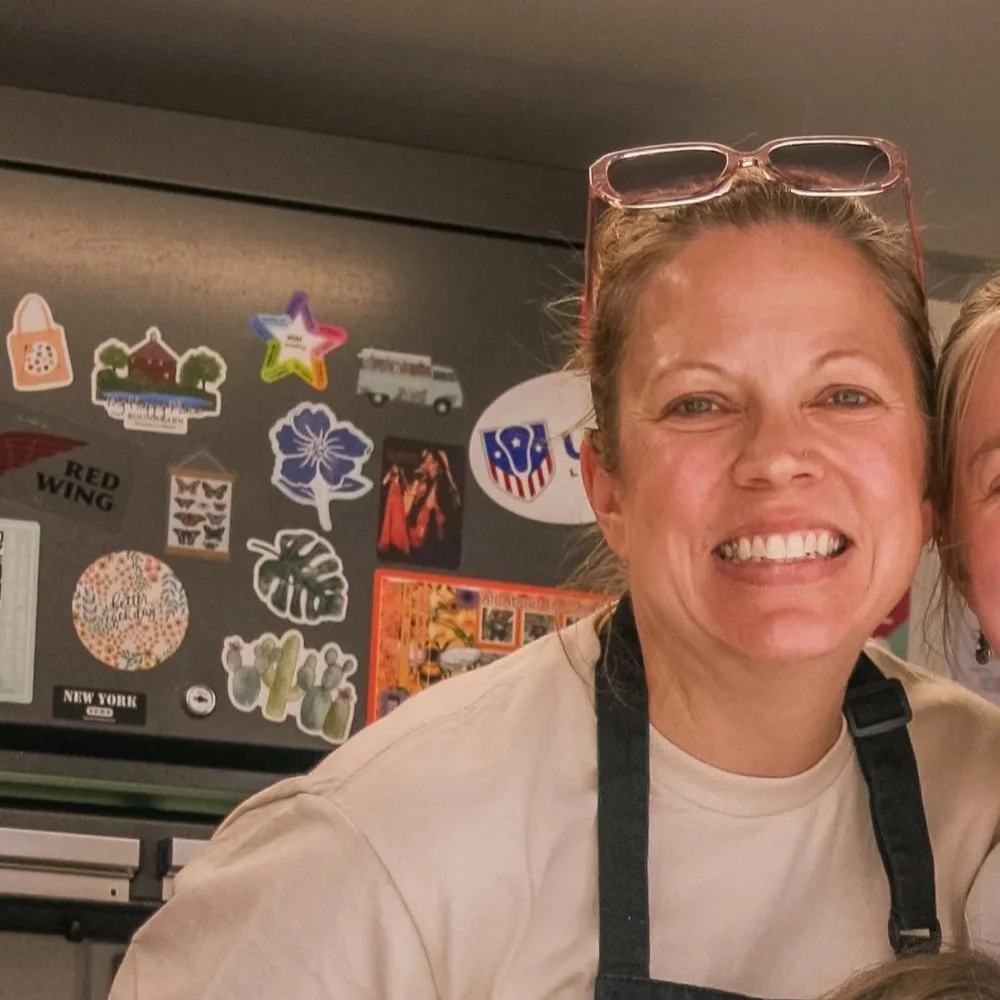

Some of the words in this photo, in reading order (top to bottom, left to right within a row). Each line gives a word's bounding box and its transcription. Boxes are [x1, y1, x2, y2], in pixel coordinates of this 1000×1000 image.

[37, 471, 115, 512] WING
[64, 460, 120, 492] RED
[63, 689, 94, 705] NEW
[97, 691, 138, 708] YORK
